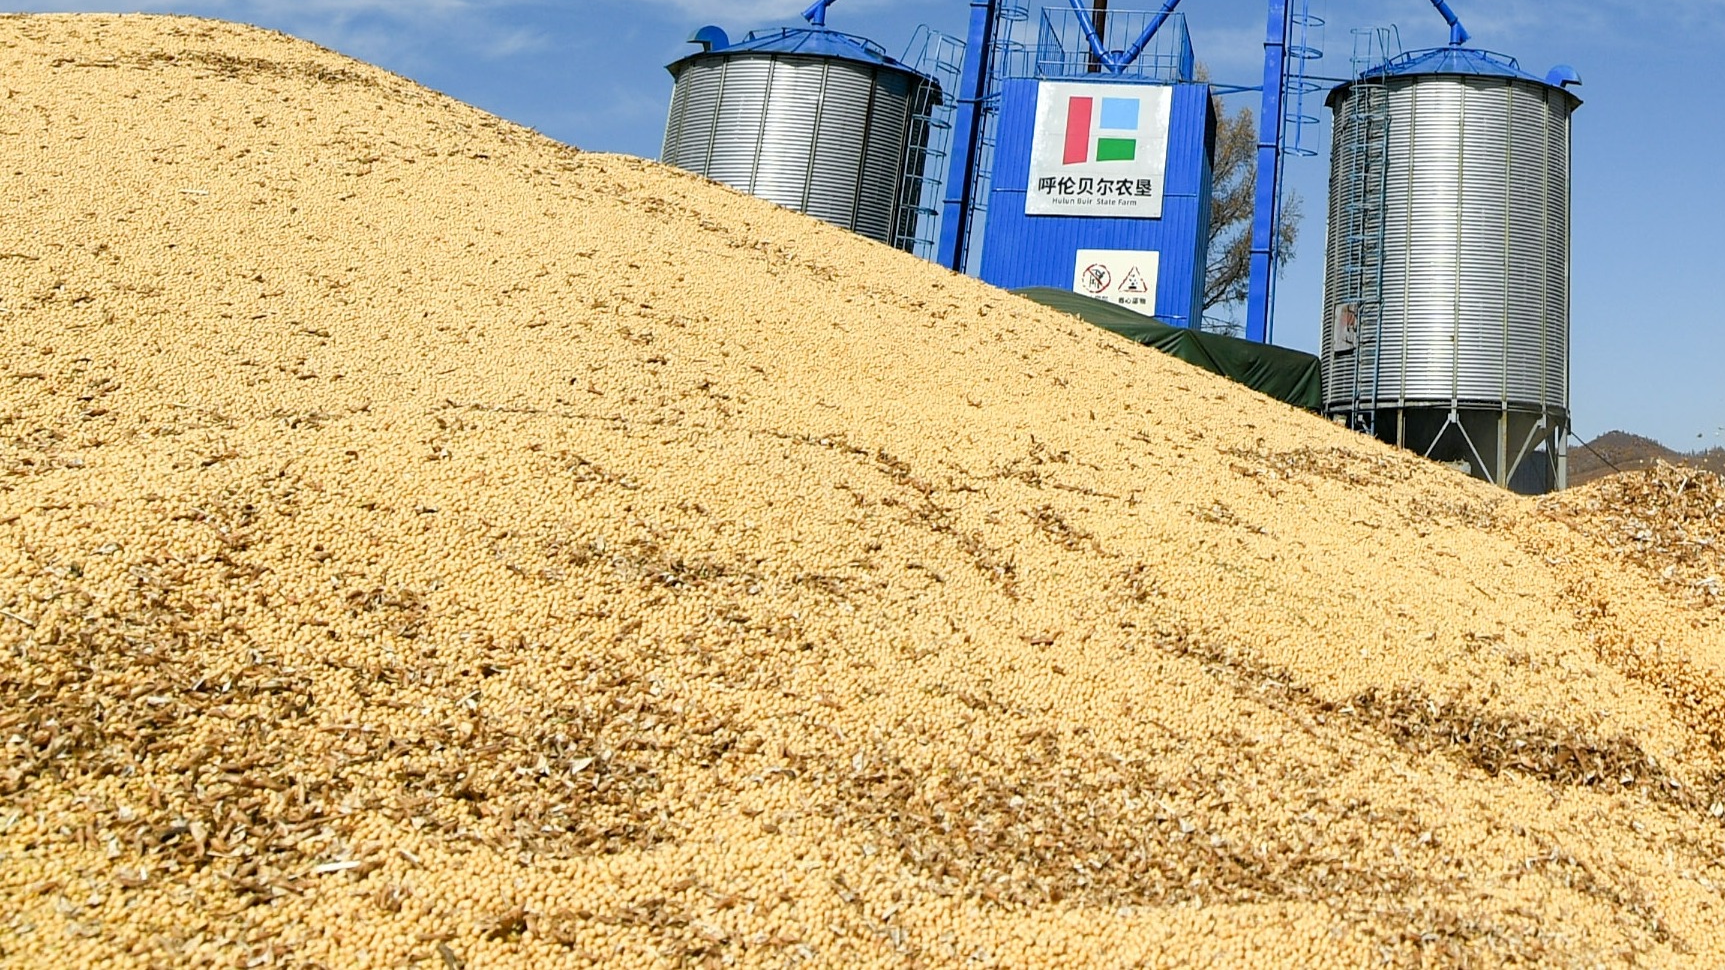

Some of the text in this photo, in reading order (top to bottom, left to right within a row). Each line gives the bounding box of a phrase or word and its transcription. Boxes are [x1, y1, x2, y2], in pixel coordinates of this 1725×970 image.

[1038, 176, 1152, 197] 呼伦贝尔农垦
[1052, 197, 1075, 205] Hulun
[1096, 198, 1116, 206] State
